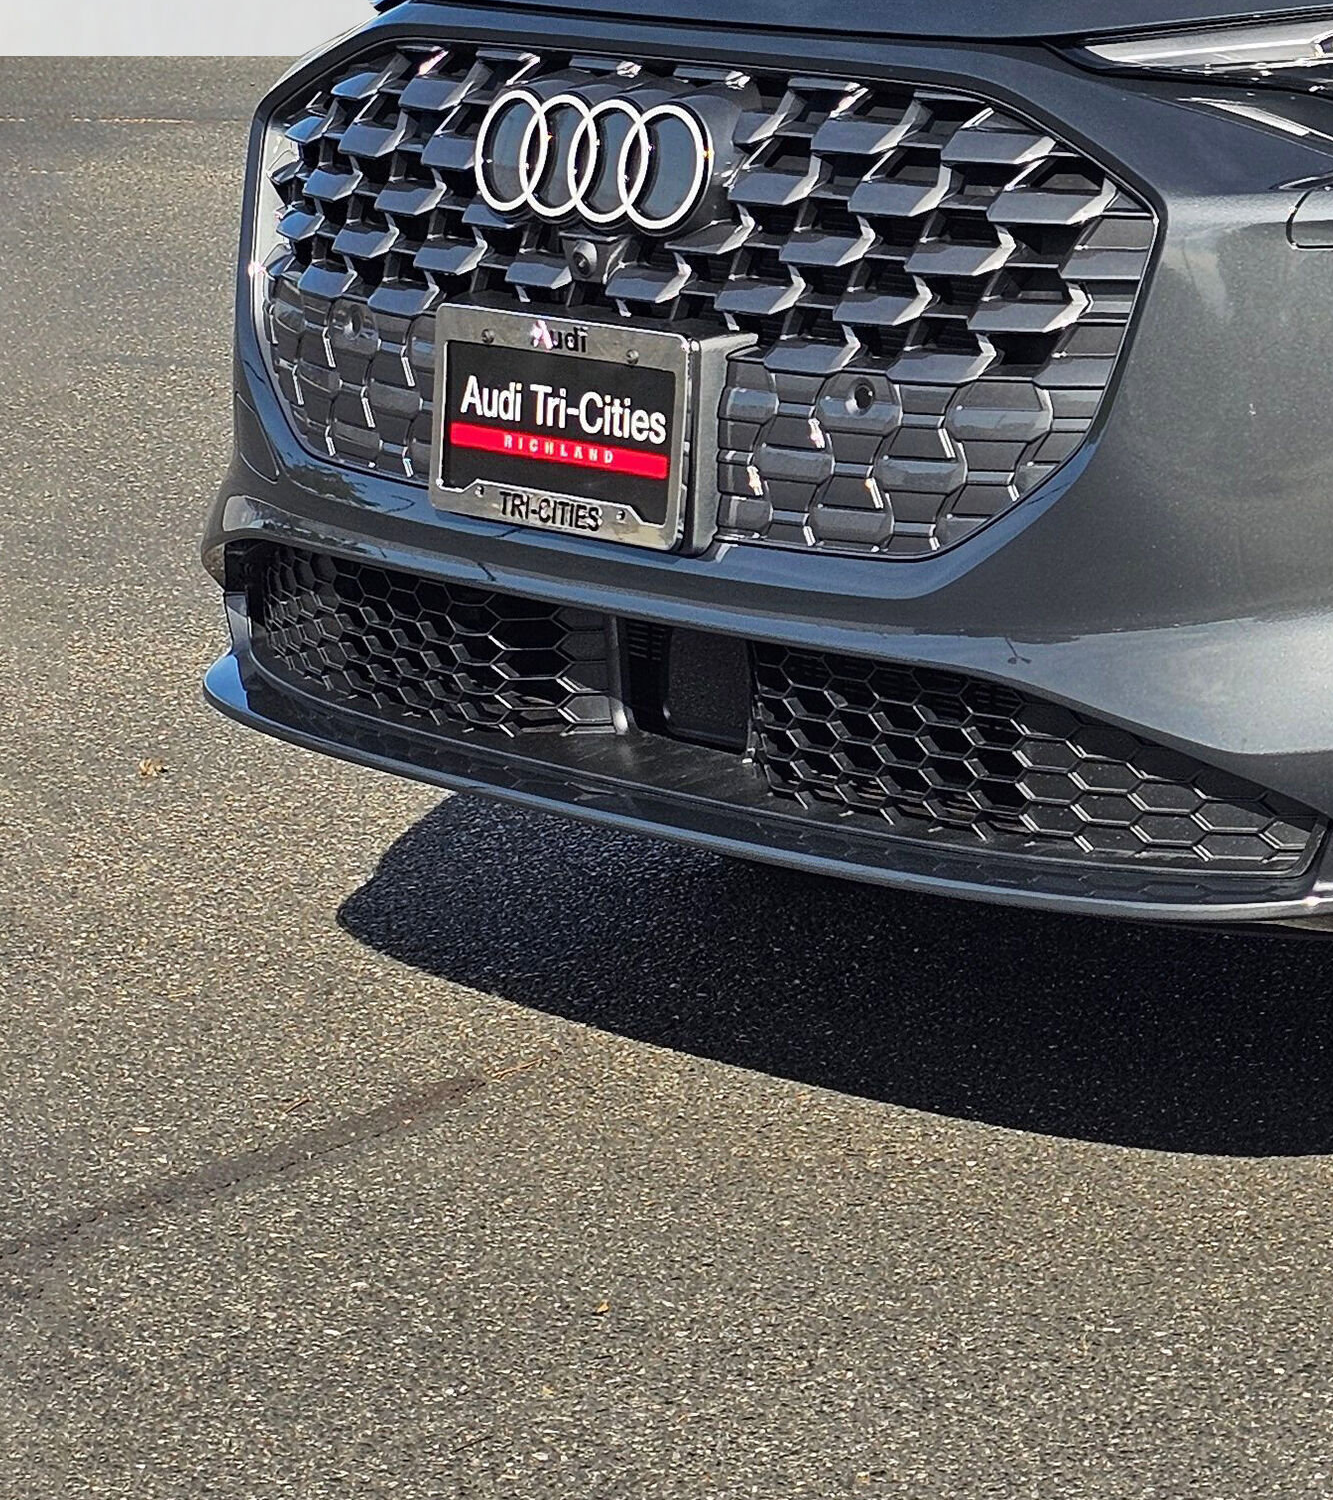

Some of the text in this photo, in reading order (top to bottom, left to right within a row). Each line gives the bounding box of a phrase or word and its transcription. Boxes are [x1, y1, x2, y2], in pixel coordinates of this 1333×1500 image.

[530, 319, 589, 353] Audi
[460, 375, 667, 445] Audi Tri-Cities
[503, 435, 614, 464] RICHLAND
[499, 490, 603, 532] TRI-CITIES
